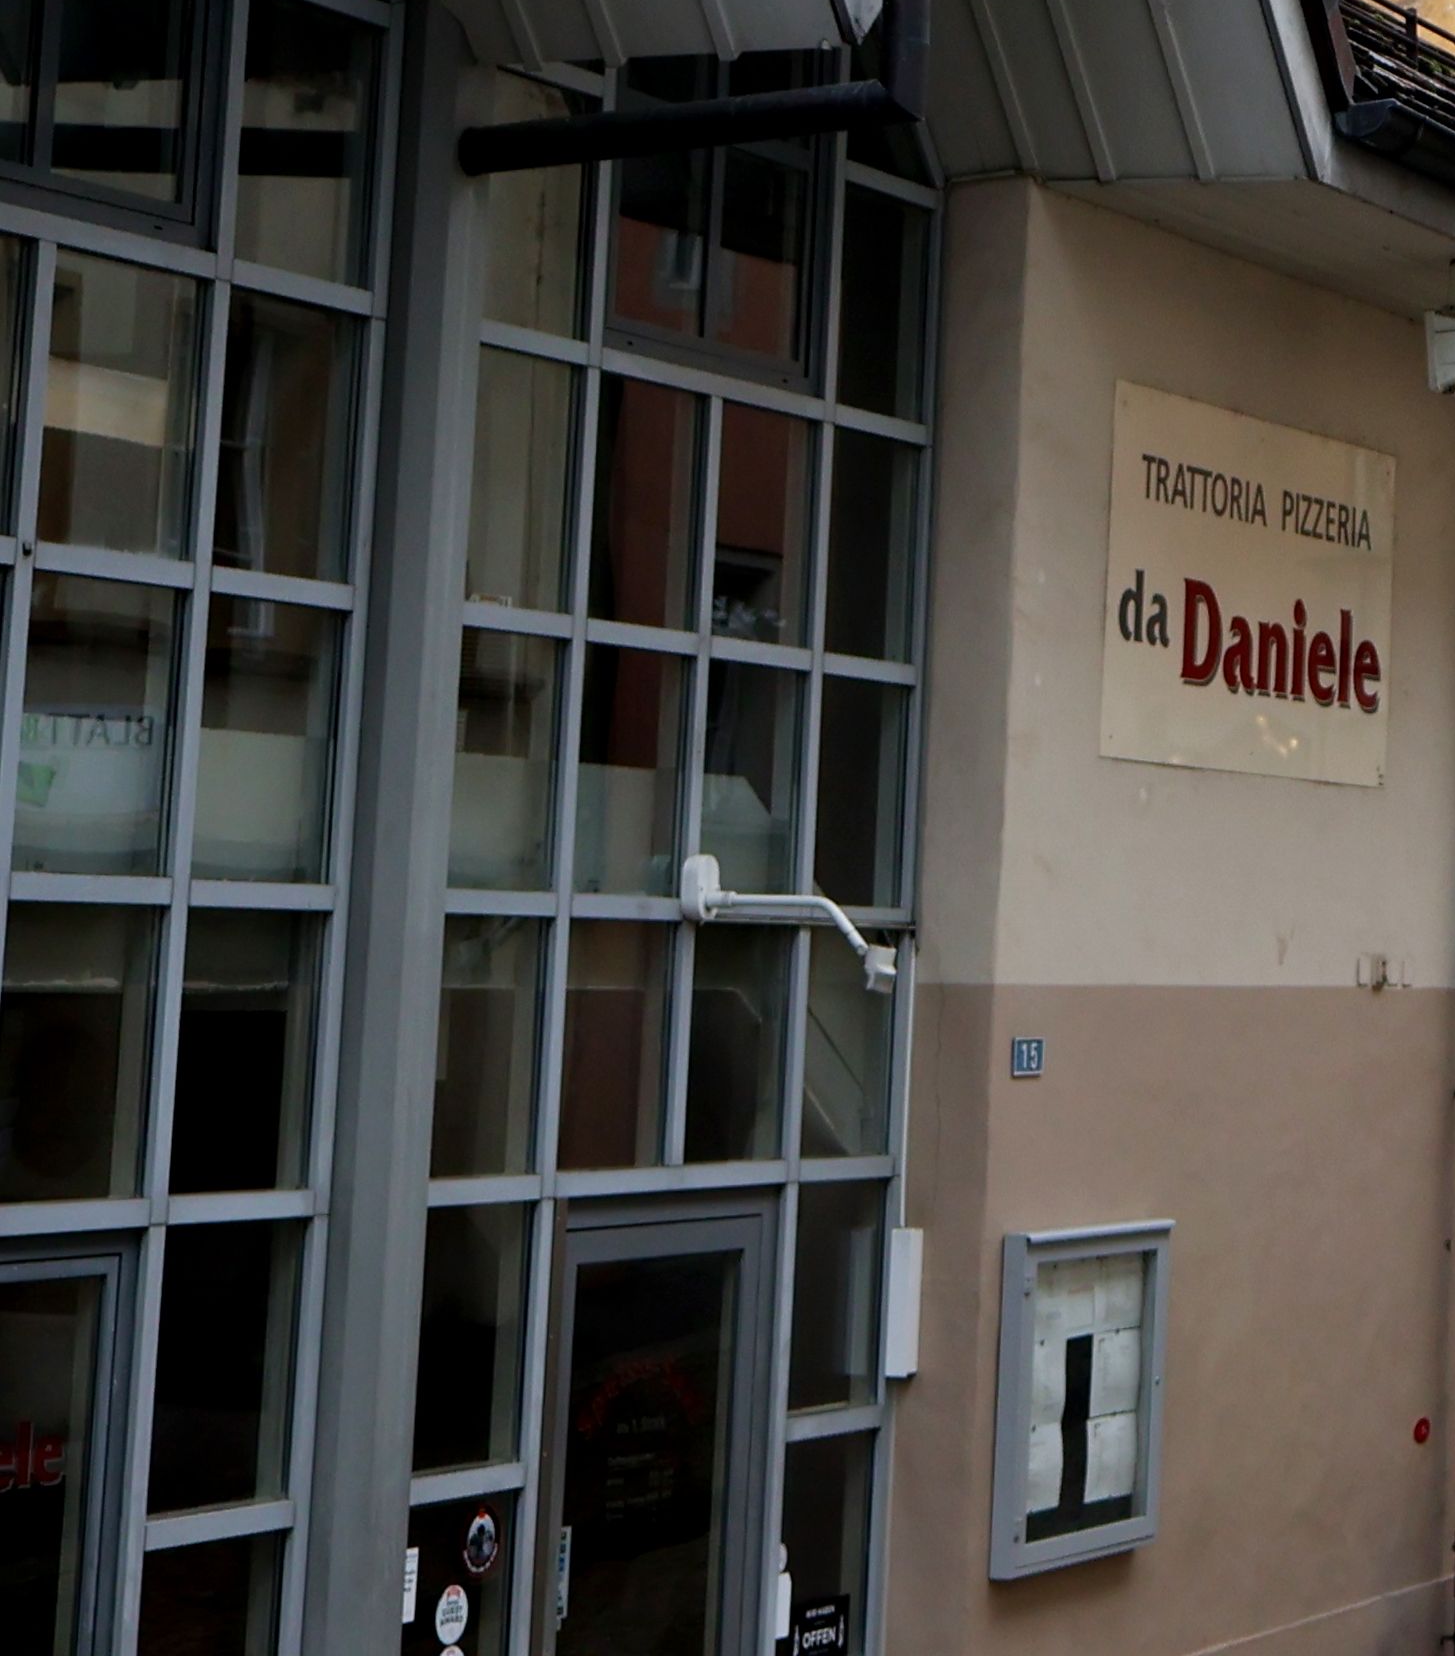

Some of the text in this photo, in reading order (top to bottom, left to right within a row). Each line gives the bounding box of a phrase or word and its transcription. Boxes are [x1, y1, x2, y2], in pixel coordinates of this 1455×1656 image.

[1142, 453, 1373, 551] TRATTORIA PIZZERIA
[1118, 569, 1382, 713] da Daniele
[1021, 1042, 1038, 1069] 15
[801, 1625, 837, 1649] OFFEN
